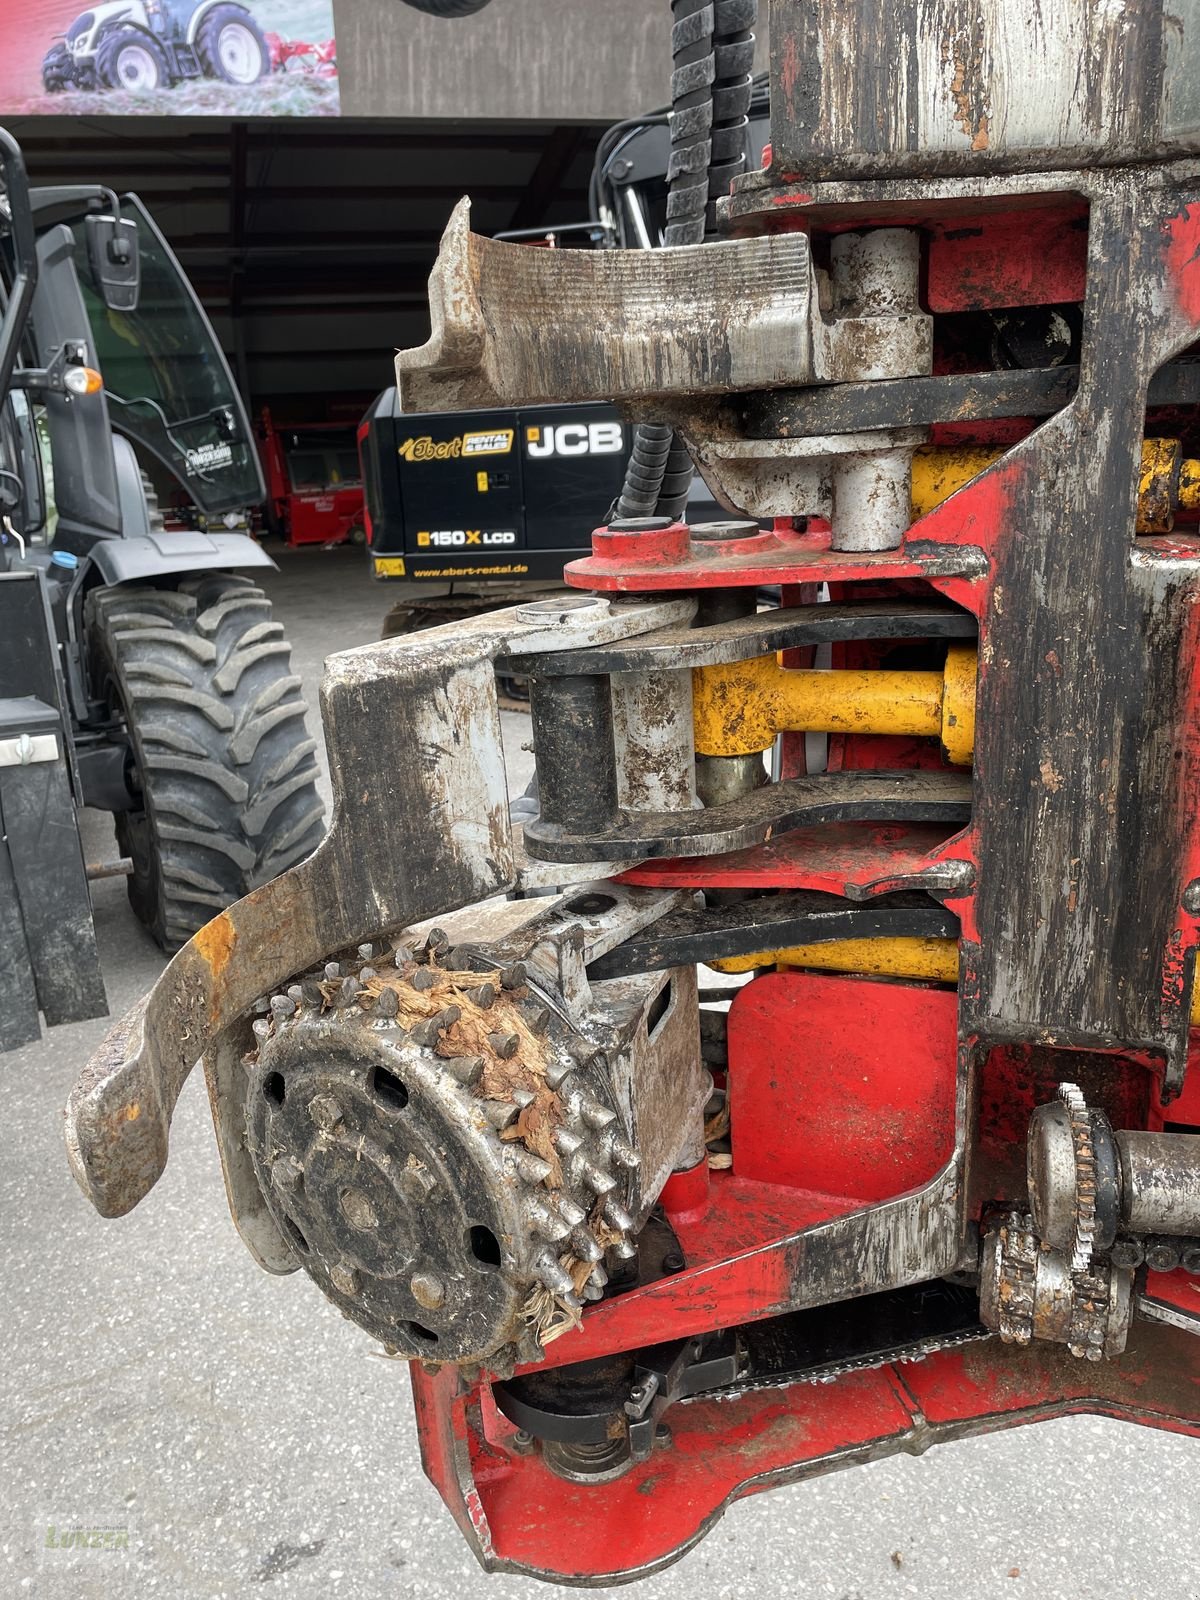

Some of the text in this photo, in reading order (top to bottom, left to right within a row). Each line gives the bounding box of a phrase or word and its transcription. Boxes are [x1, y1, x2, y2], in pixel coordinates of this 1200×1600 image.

[466, 432, 509, 445] RENTAL
[474, 440, 508, 450] SALES
[528, 423, 623, 457] JCB
[413, 436, 461, 461] Ebert
[483, 532, 516, 544] LCD
[414, 564, 529, 578] www.ebert-rental.de
